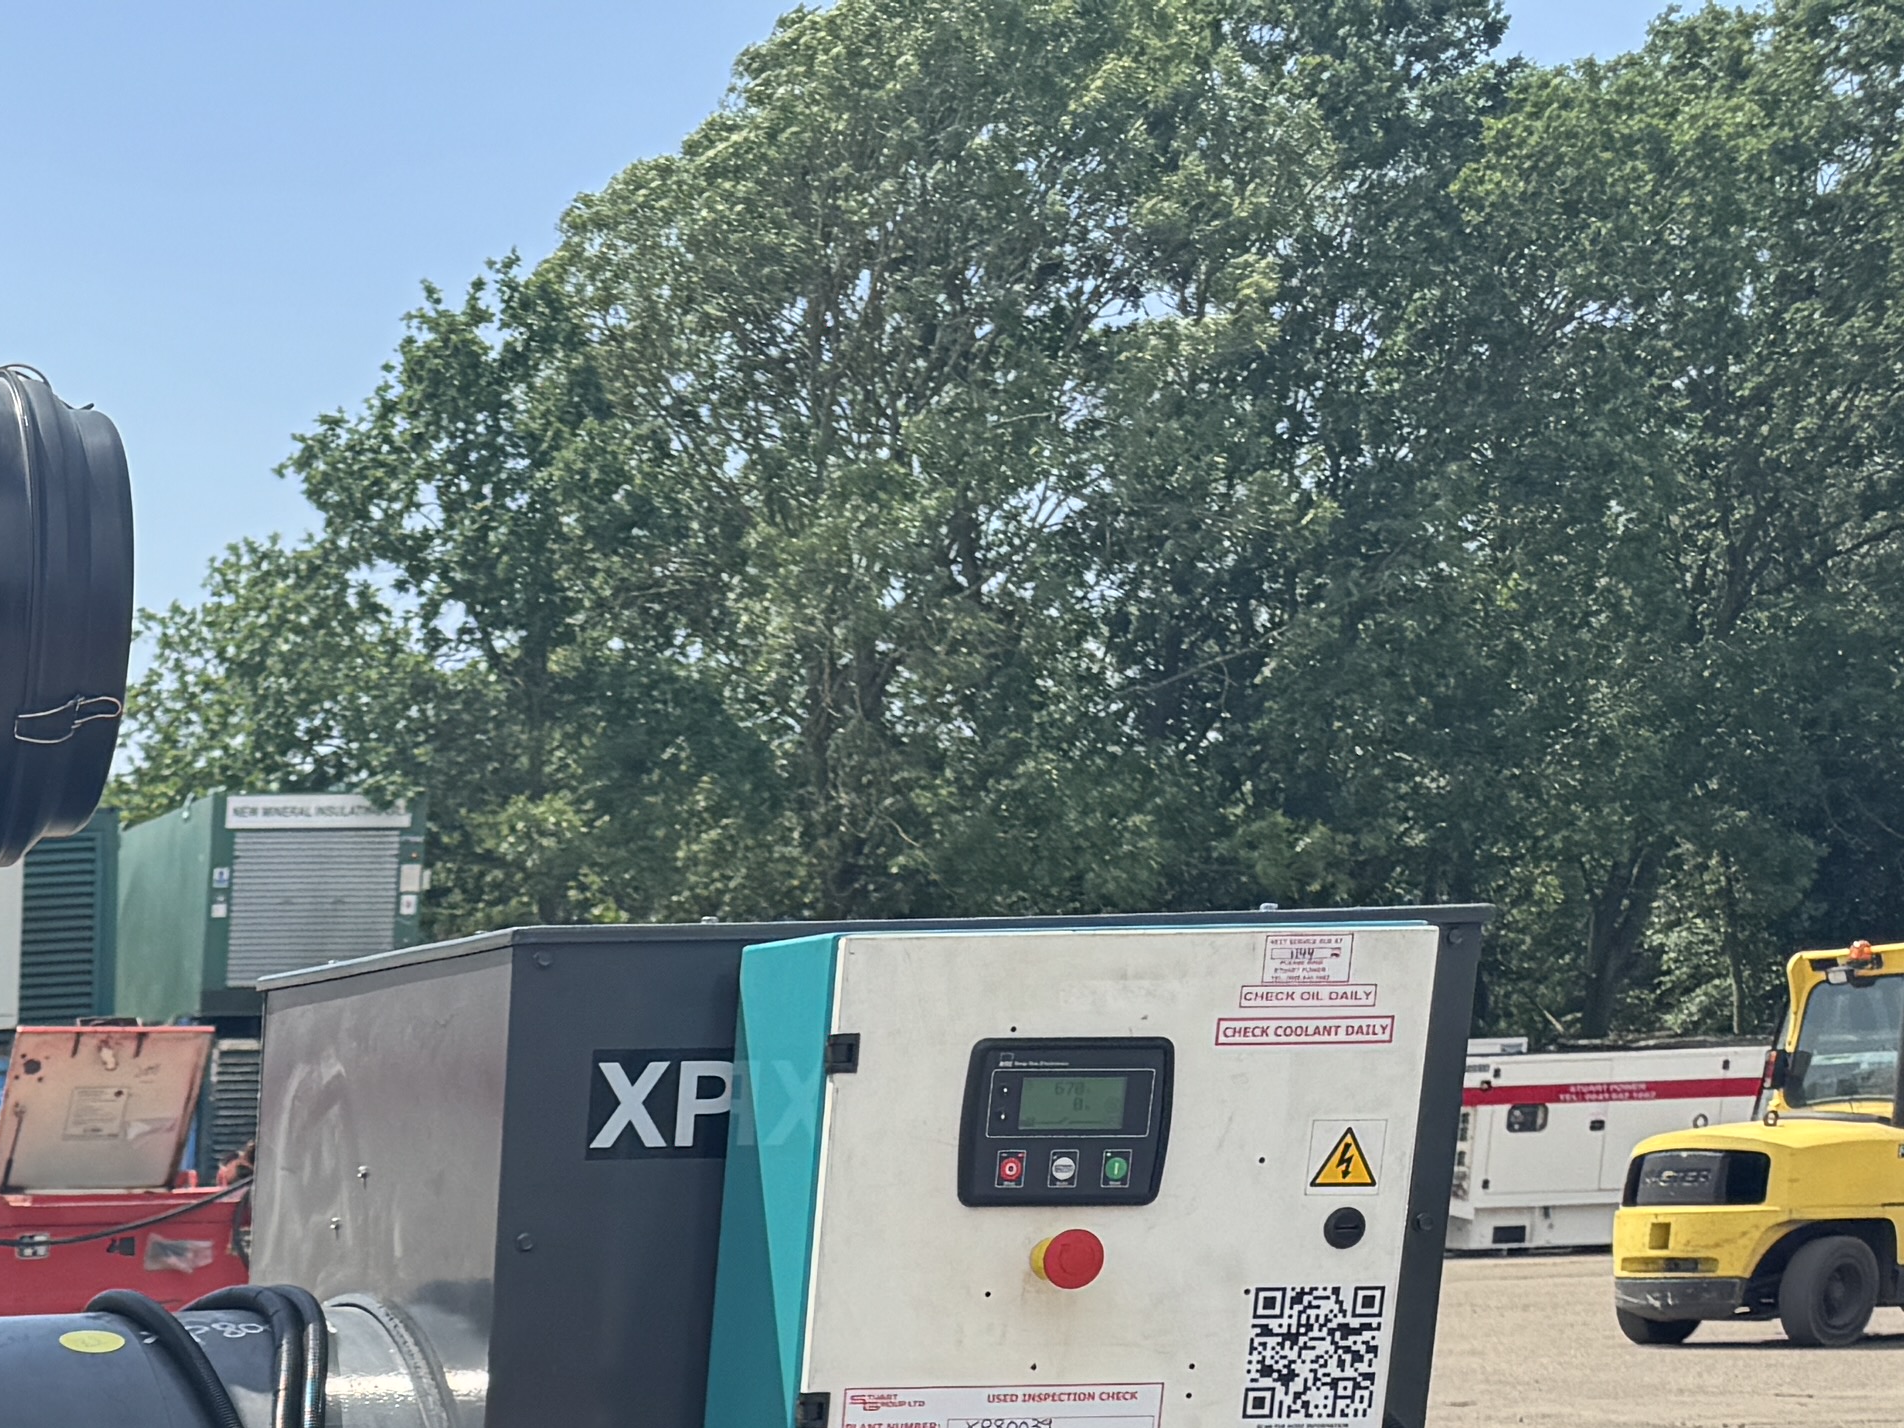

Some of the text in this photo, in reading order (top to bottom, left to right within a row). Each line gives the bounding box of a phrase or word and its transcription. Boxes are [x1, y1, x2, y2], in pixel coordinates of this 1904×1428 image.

[1244, 990, 1372, 1002] CHECK OIL DAILY
[1223, 1023, 1389, 1038] CHECK COOLANT DAILY
[589, 1061, 733, 1148] XP
[987, 1391, 1138, 1403] USED INSPECTION CHECK
